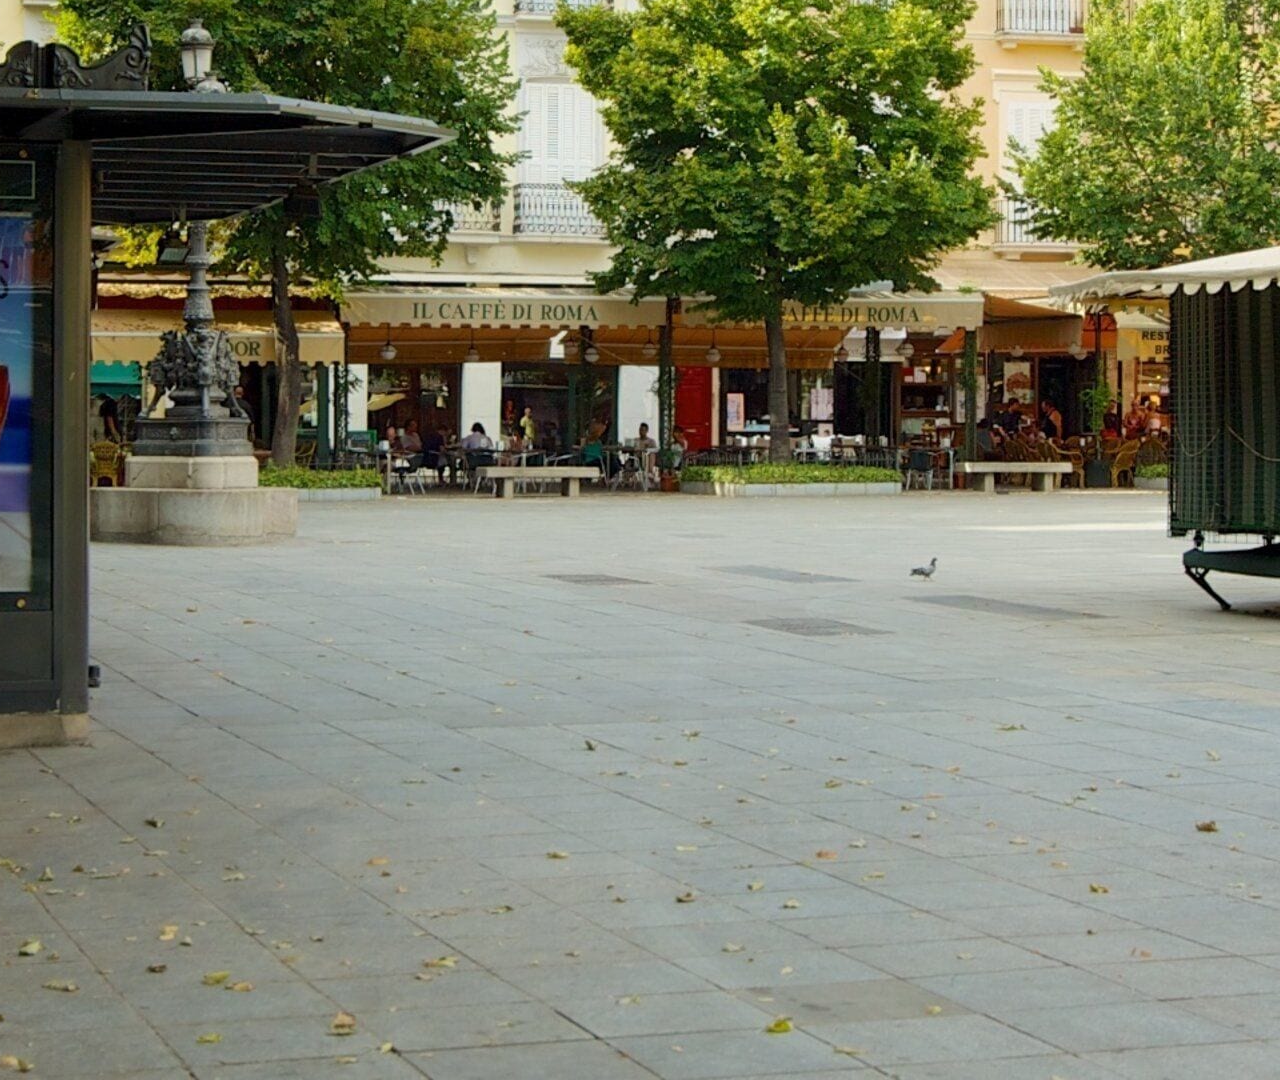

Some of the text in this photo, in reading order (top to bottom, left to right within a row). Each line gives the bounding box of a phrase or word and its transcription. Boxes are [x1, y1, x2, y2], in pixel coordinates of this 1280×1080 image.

[412, 299, 598, 321] IL CAFFÈ DI ROMA
[841, 306, 860, 322] DI
[868, 306, 919, 323] ROMA
